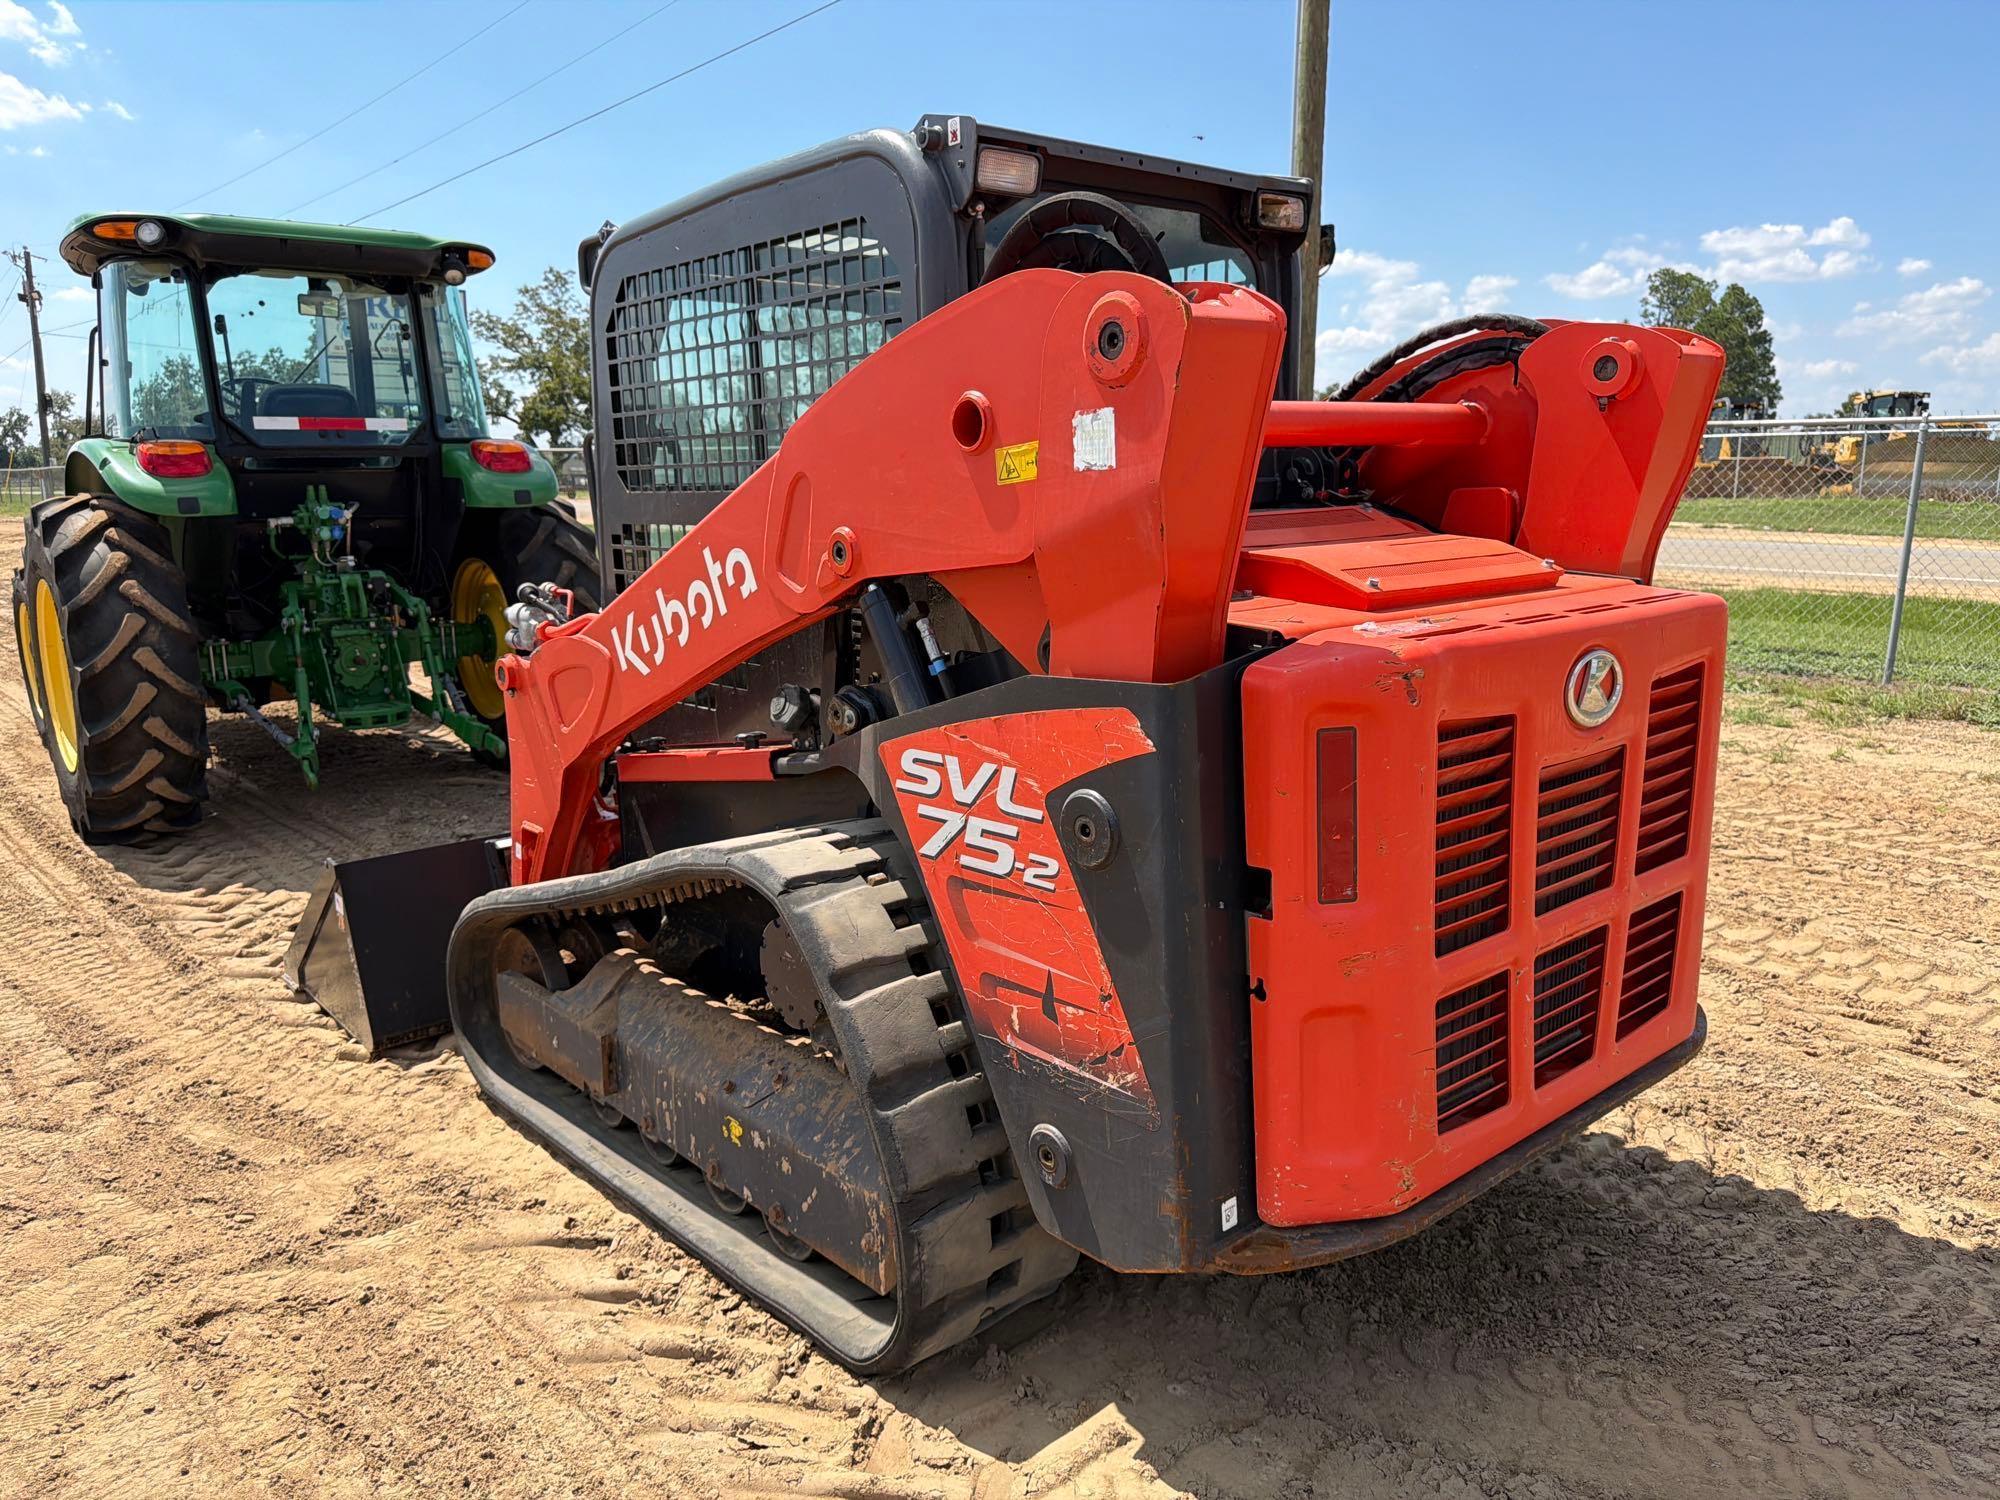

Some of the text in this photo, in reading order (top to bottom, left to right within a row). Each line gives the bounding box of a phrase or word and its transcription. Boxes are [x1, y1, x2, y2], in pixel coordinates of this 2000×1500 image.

[611, 546, 758, 676] Kubota
[895, 748, 1044, 823] SVL
[918, 803, 1060, 892] 75-2
